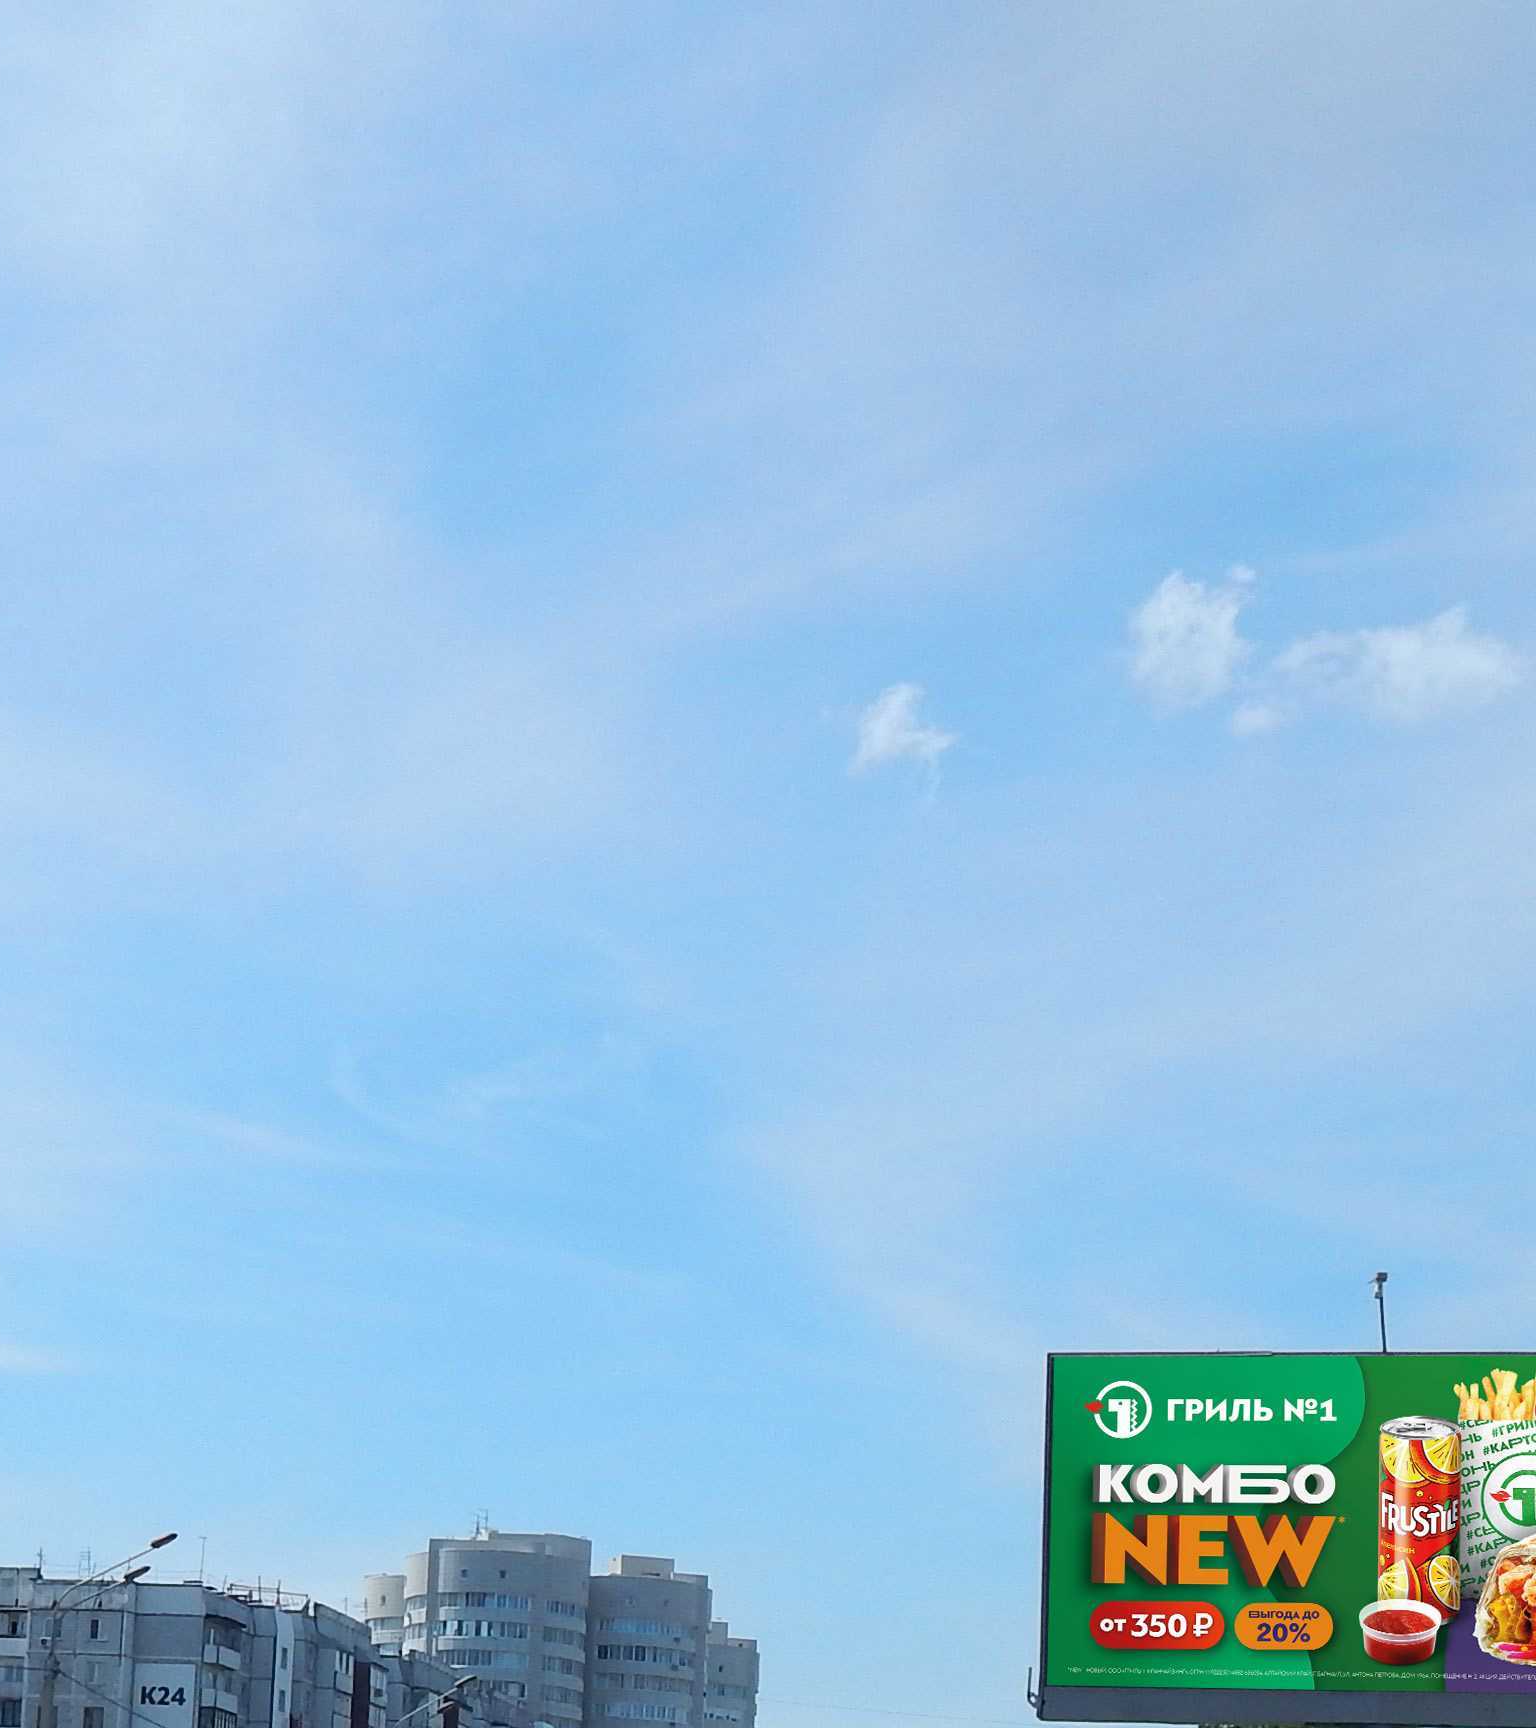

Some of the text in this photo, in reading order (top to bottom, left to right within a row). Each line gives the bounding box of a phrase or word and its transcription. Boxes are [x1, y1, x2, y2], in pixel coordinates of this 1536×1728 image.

[1167, 1398, 1338, 1422] ГРИЛЬ №1
[1097, 1463, 1337, 1505] КОМБО
[1099, 1618, 1126, 1632] от
[1130, 1613, 1187, 1638] 350
[1247, 1610, 1320, 1620] ВЫГОДА ДО
[1256, 1622, 1311, 1643] 20%
